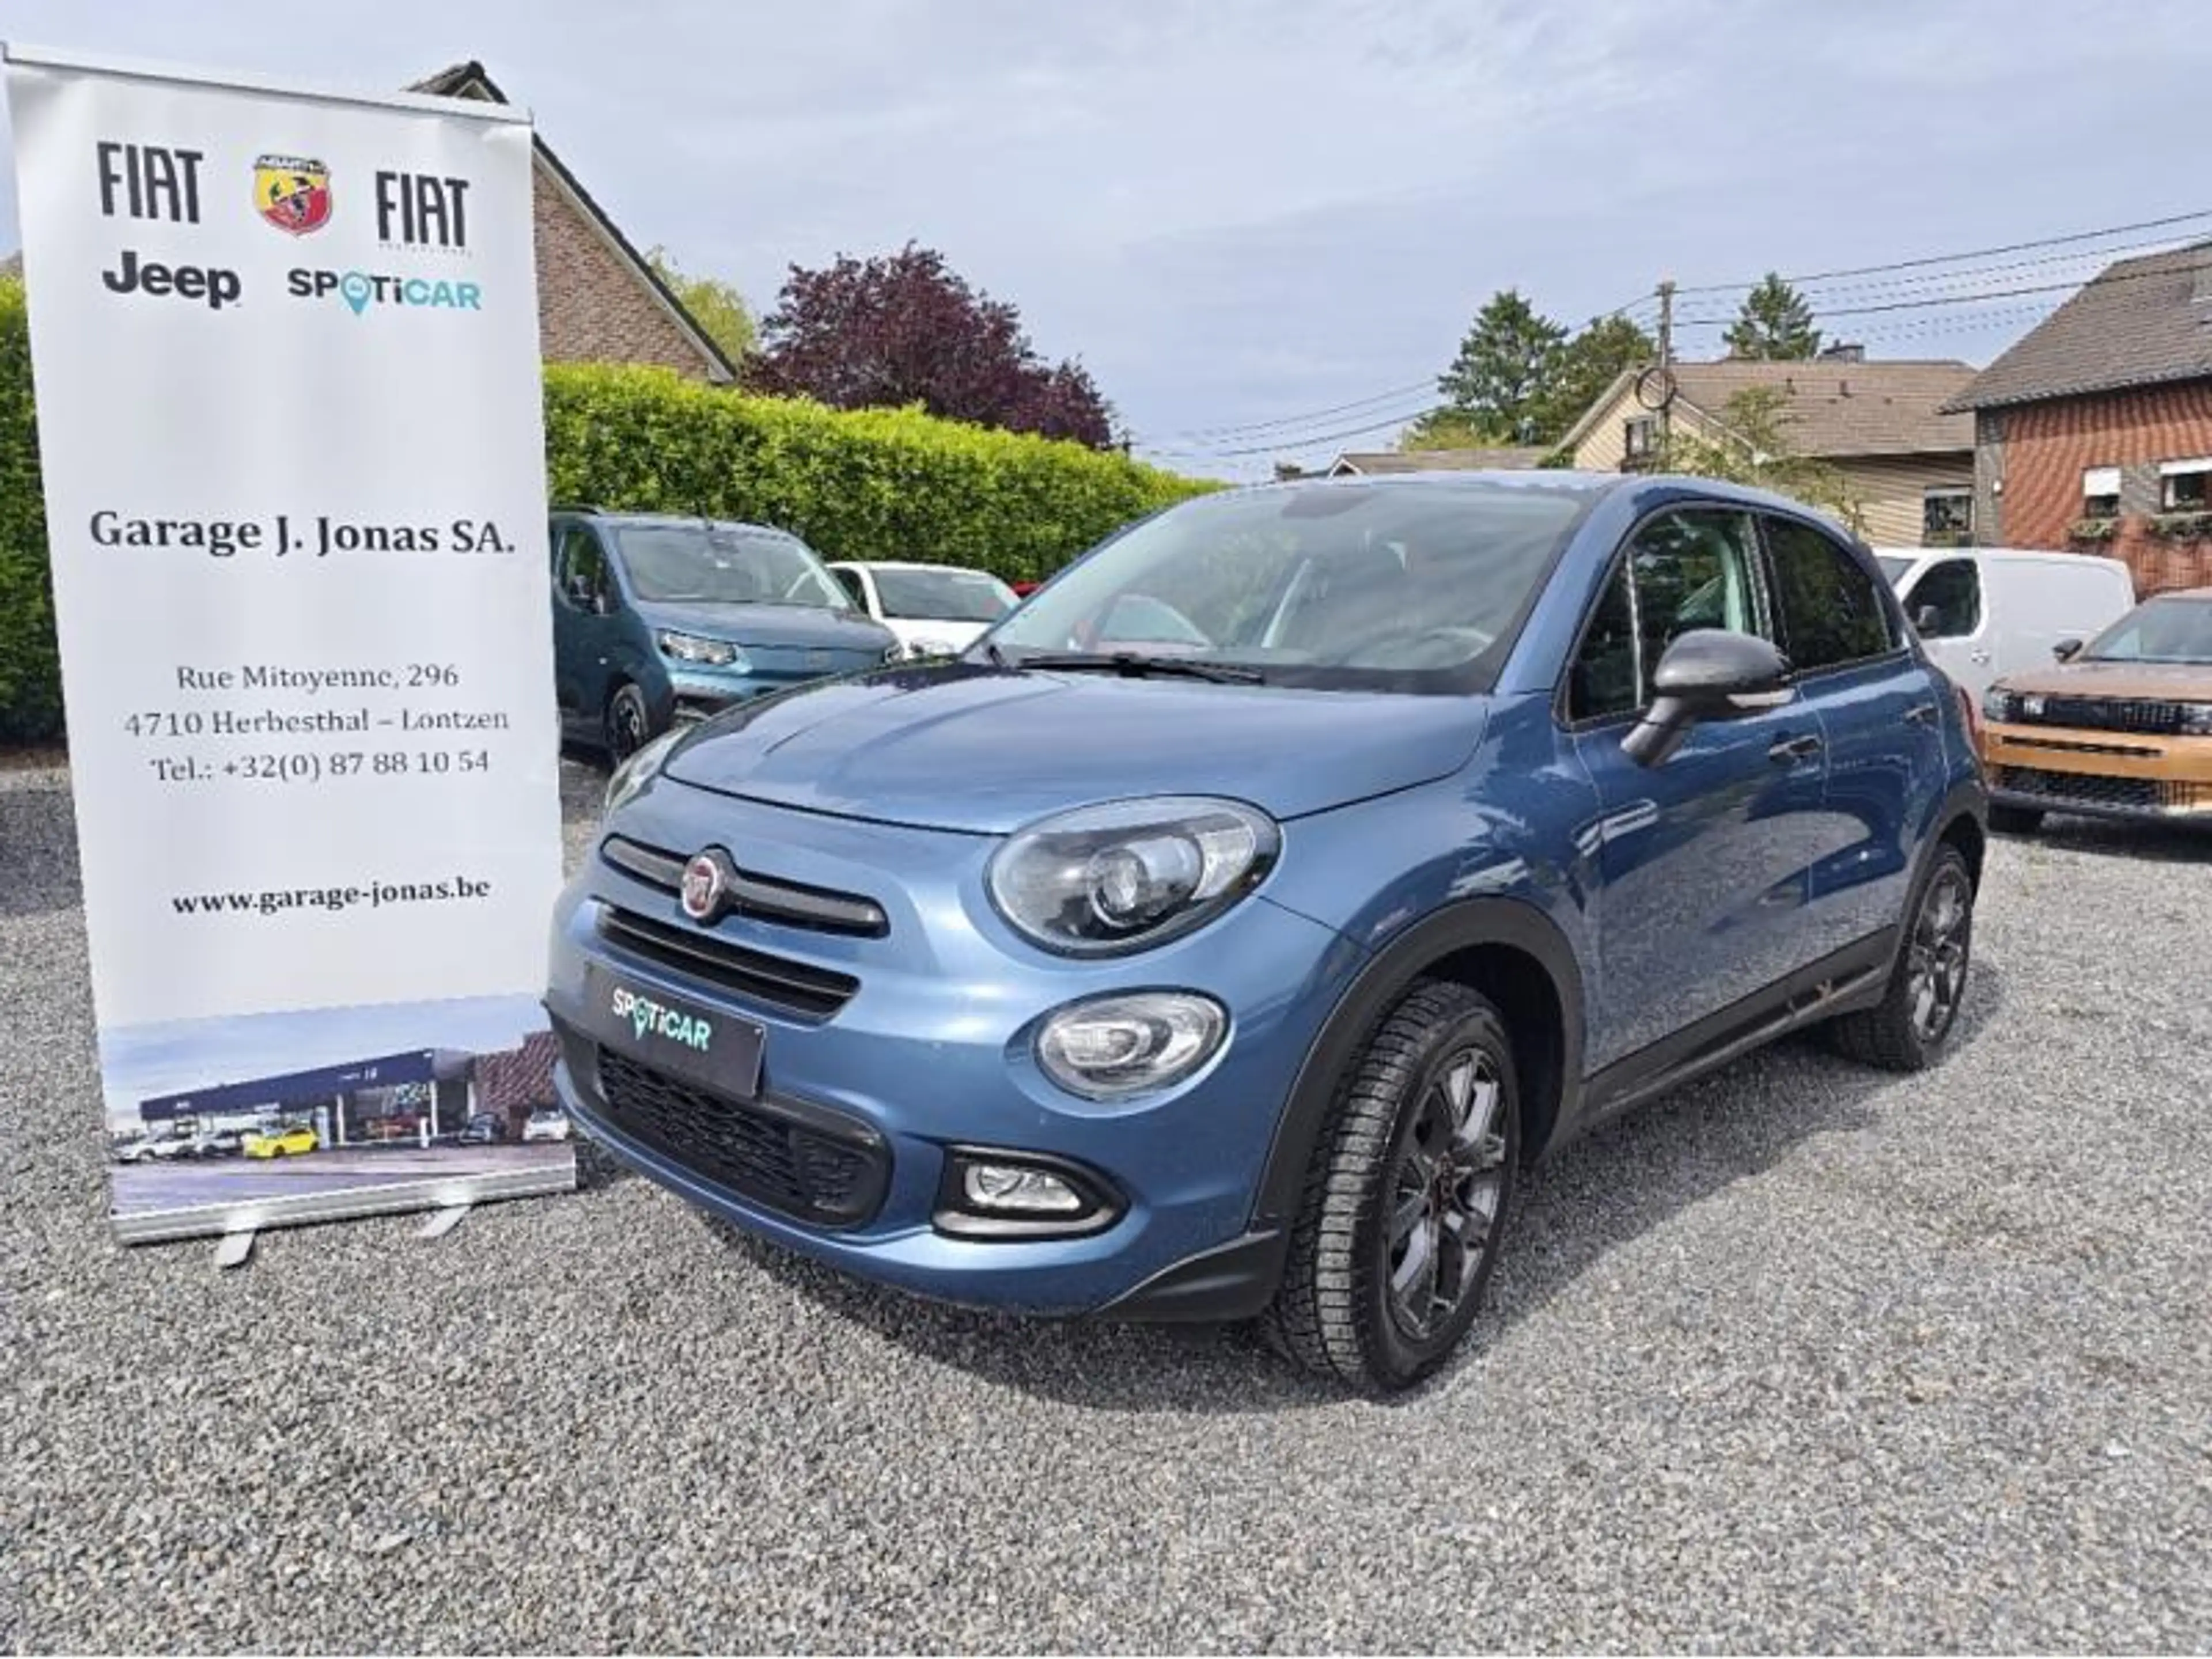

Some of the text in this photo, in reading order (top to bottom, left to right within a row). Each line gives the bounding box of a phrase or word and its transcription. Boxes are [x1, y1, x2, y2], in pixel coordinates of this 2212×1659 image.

[97, 142, 203, 224] FIAT
[376, 171, 469, 247] FIAT
[102, 251, 241, 309] Jeep
[90, 510, 516, 557] Garage J. Jonas SA.
[176, 665, 234, 690] Rue
[407, 664, 459, 687] 296
[123, 712, 203, 736] 4710
[212, 707, 369, 734] Herbesthal
[403, 708, 509, 730] Lontzen
[222, 752, 321, 782] +32(0)
[329, 752, 363, 775] 87
[373, 752, 408, 775] 88
[418, 752, 449, 773] 10
[459, 749, 488, 772] 54
[172, 876, 491, 915] www.garage-jonas.be
